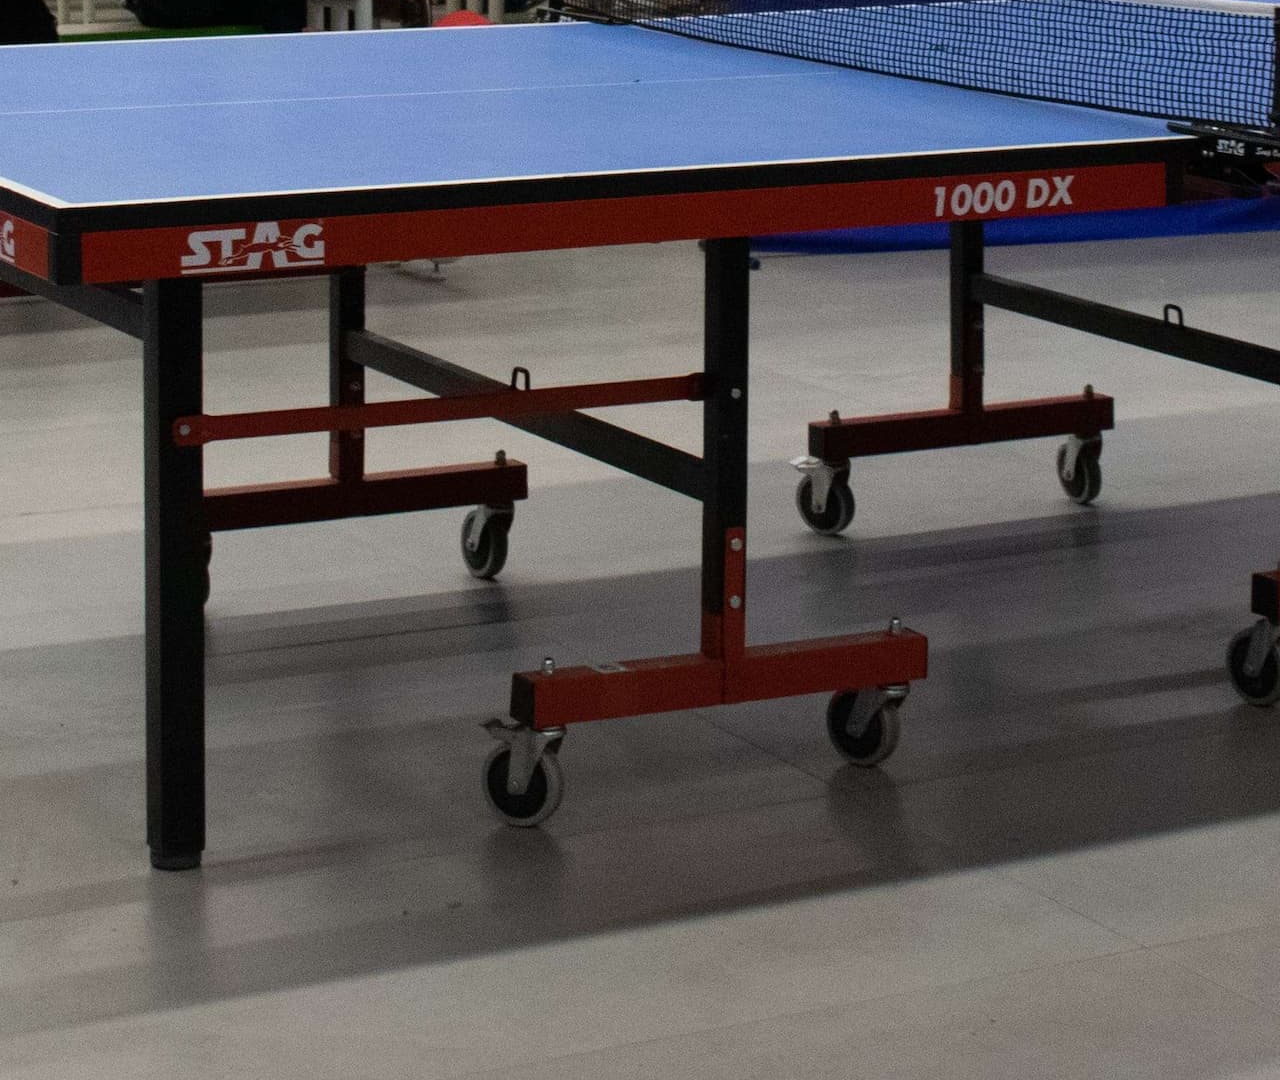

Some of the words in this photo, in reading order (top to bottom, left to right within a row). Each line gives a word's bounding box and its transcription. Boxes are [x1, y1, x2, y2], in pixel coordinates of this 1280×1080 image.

[934, 179, 1017, 217] 1000
[1026, 175, 1075, 209] DX
[180, 220, 326, 275] STAG
